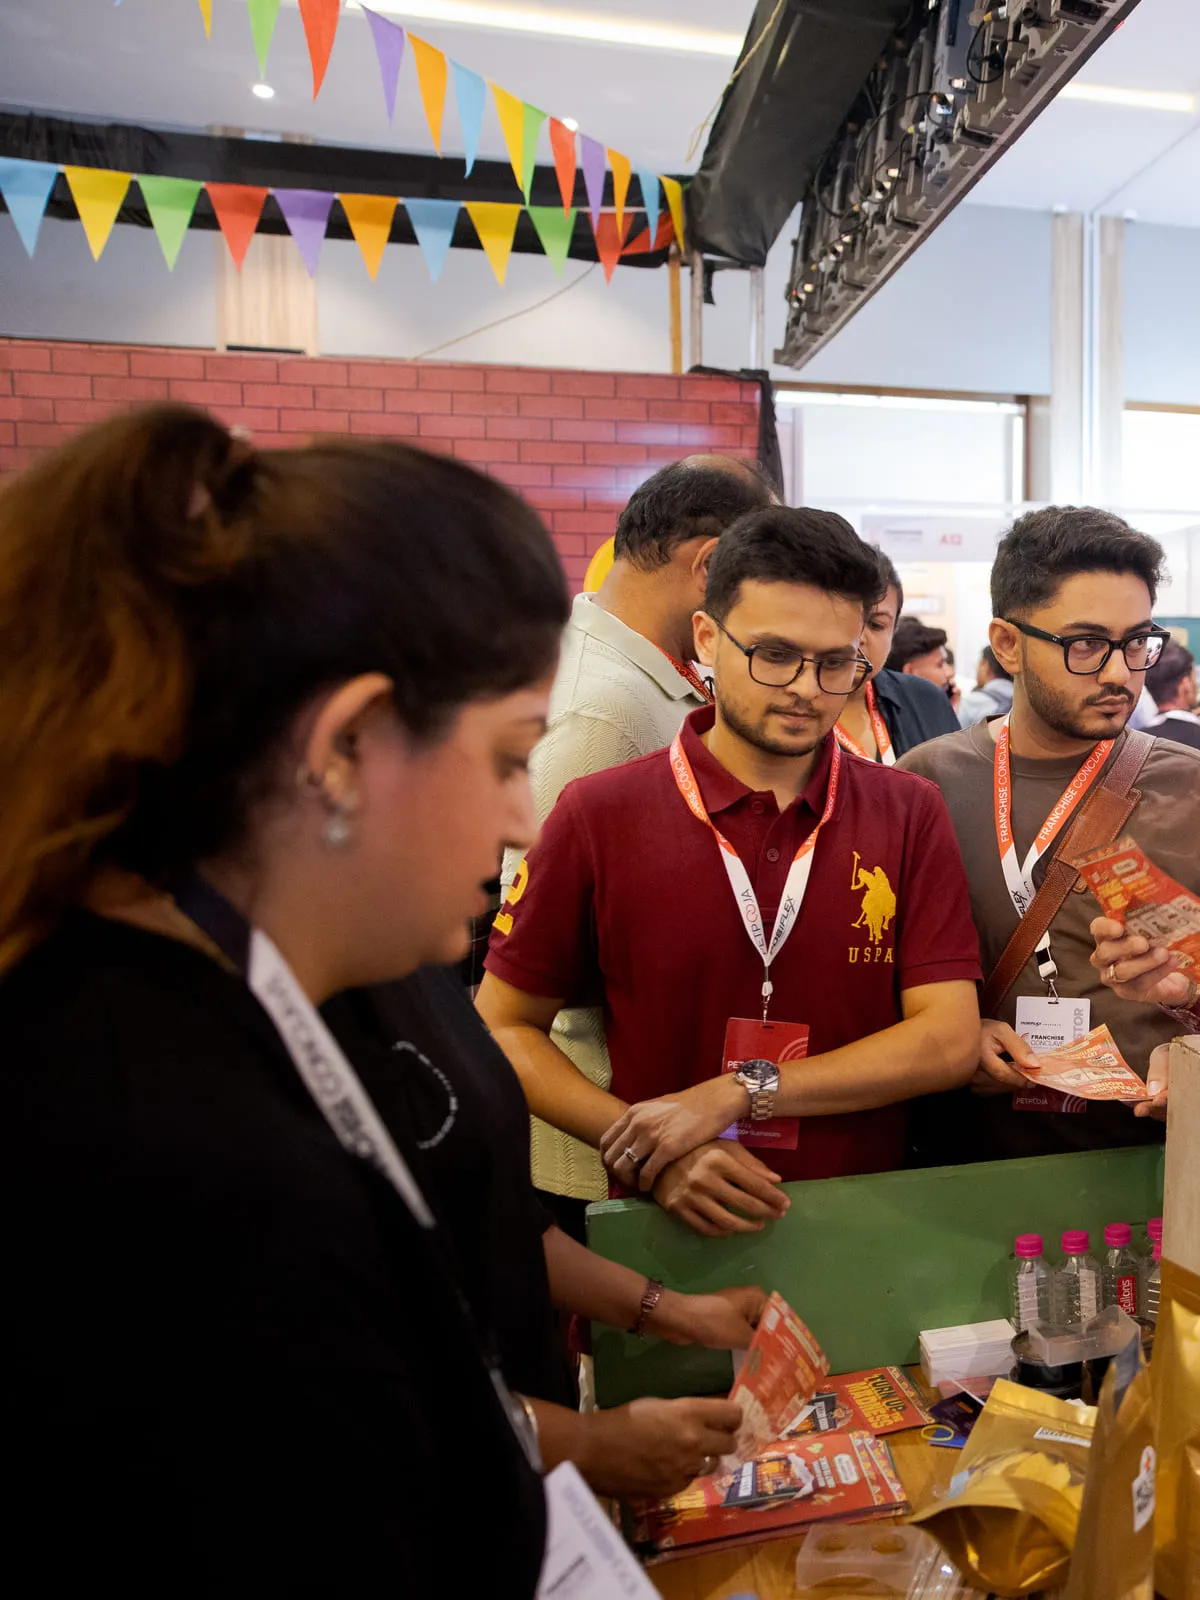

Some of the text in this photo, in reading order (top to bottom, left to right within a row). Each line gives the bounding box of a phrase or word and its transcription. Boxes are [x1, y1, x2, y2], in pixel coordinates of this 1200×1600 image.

[998, 731, 1009, 843] FRANCHISE CONCLAVE
[1039, 740, 1110, 841] FRANCHISE CONCLAVE
[867, 1373, 897, 1400] TURN
[884, 1398, 908, 1412] UP
